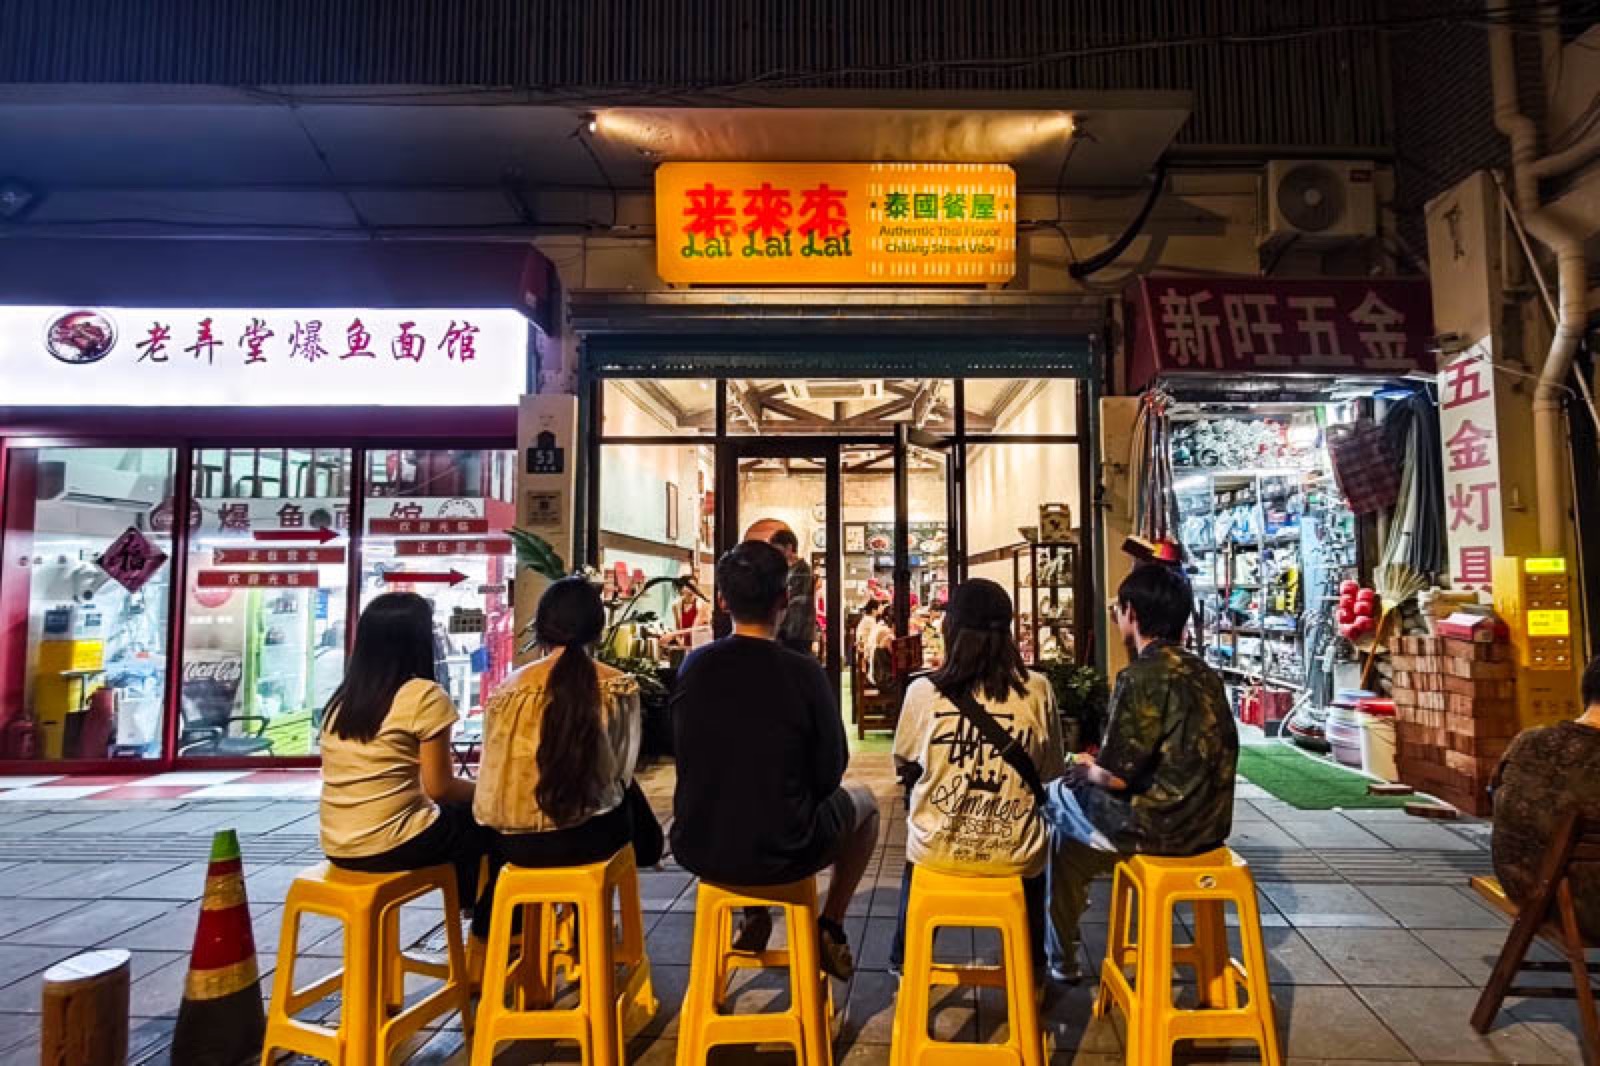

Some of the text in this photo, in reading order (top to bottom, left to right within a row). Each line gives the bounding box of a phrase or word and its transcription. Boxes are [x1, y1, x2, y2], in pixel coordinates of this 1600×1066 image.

[884, 192, 996, 220] 泰國餐屋
[135, 317, 480, 364] 老弄堂爆鱼面馆
[1160, 288, 1416, 368] 新旺五金
[1442, 354, 1498, 592] 五金灯具
